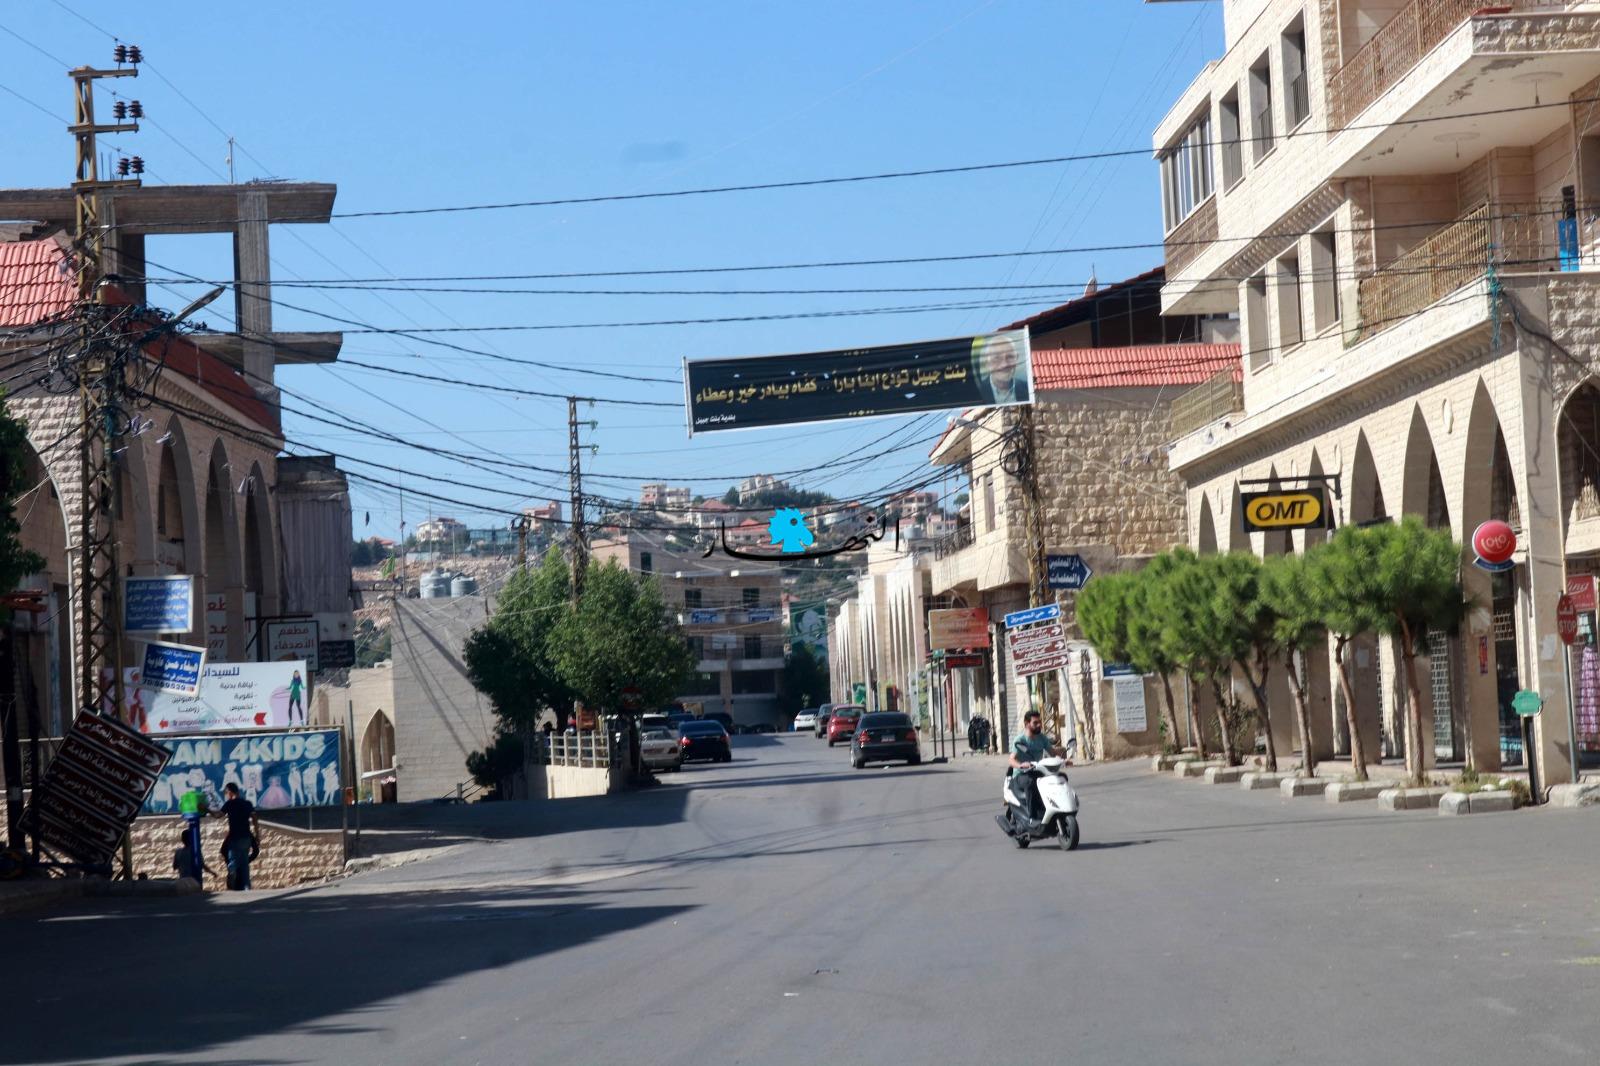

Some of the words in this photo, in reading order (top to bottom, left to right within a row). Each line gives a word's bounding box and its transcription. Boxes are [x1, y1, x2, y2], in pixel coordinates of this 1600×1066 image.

[912, 367, 941, 386] جبيل
[1256, 500, 1310, 521] OMT
[278, 624, 310, 638] مطعم
[1559, 620, 1577, 632] STOP
[229, 733, 326, 763] 4KIDS
